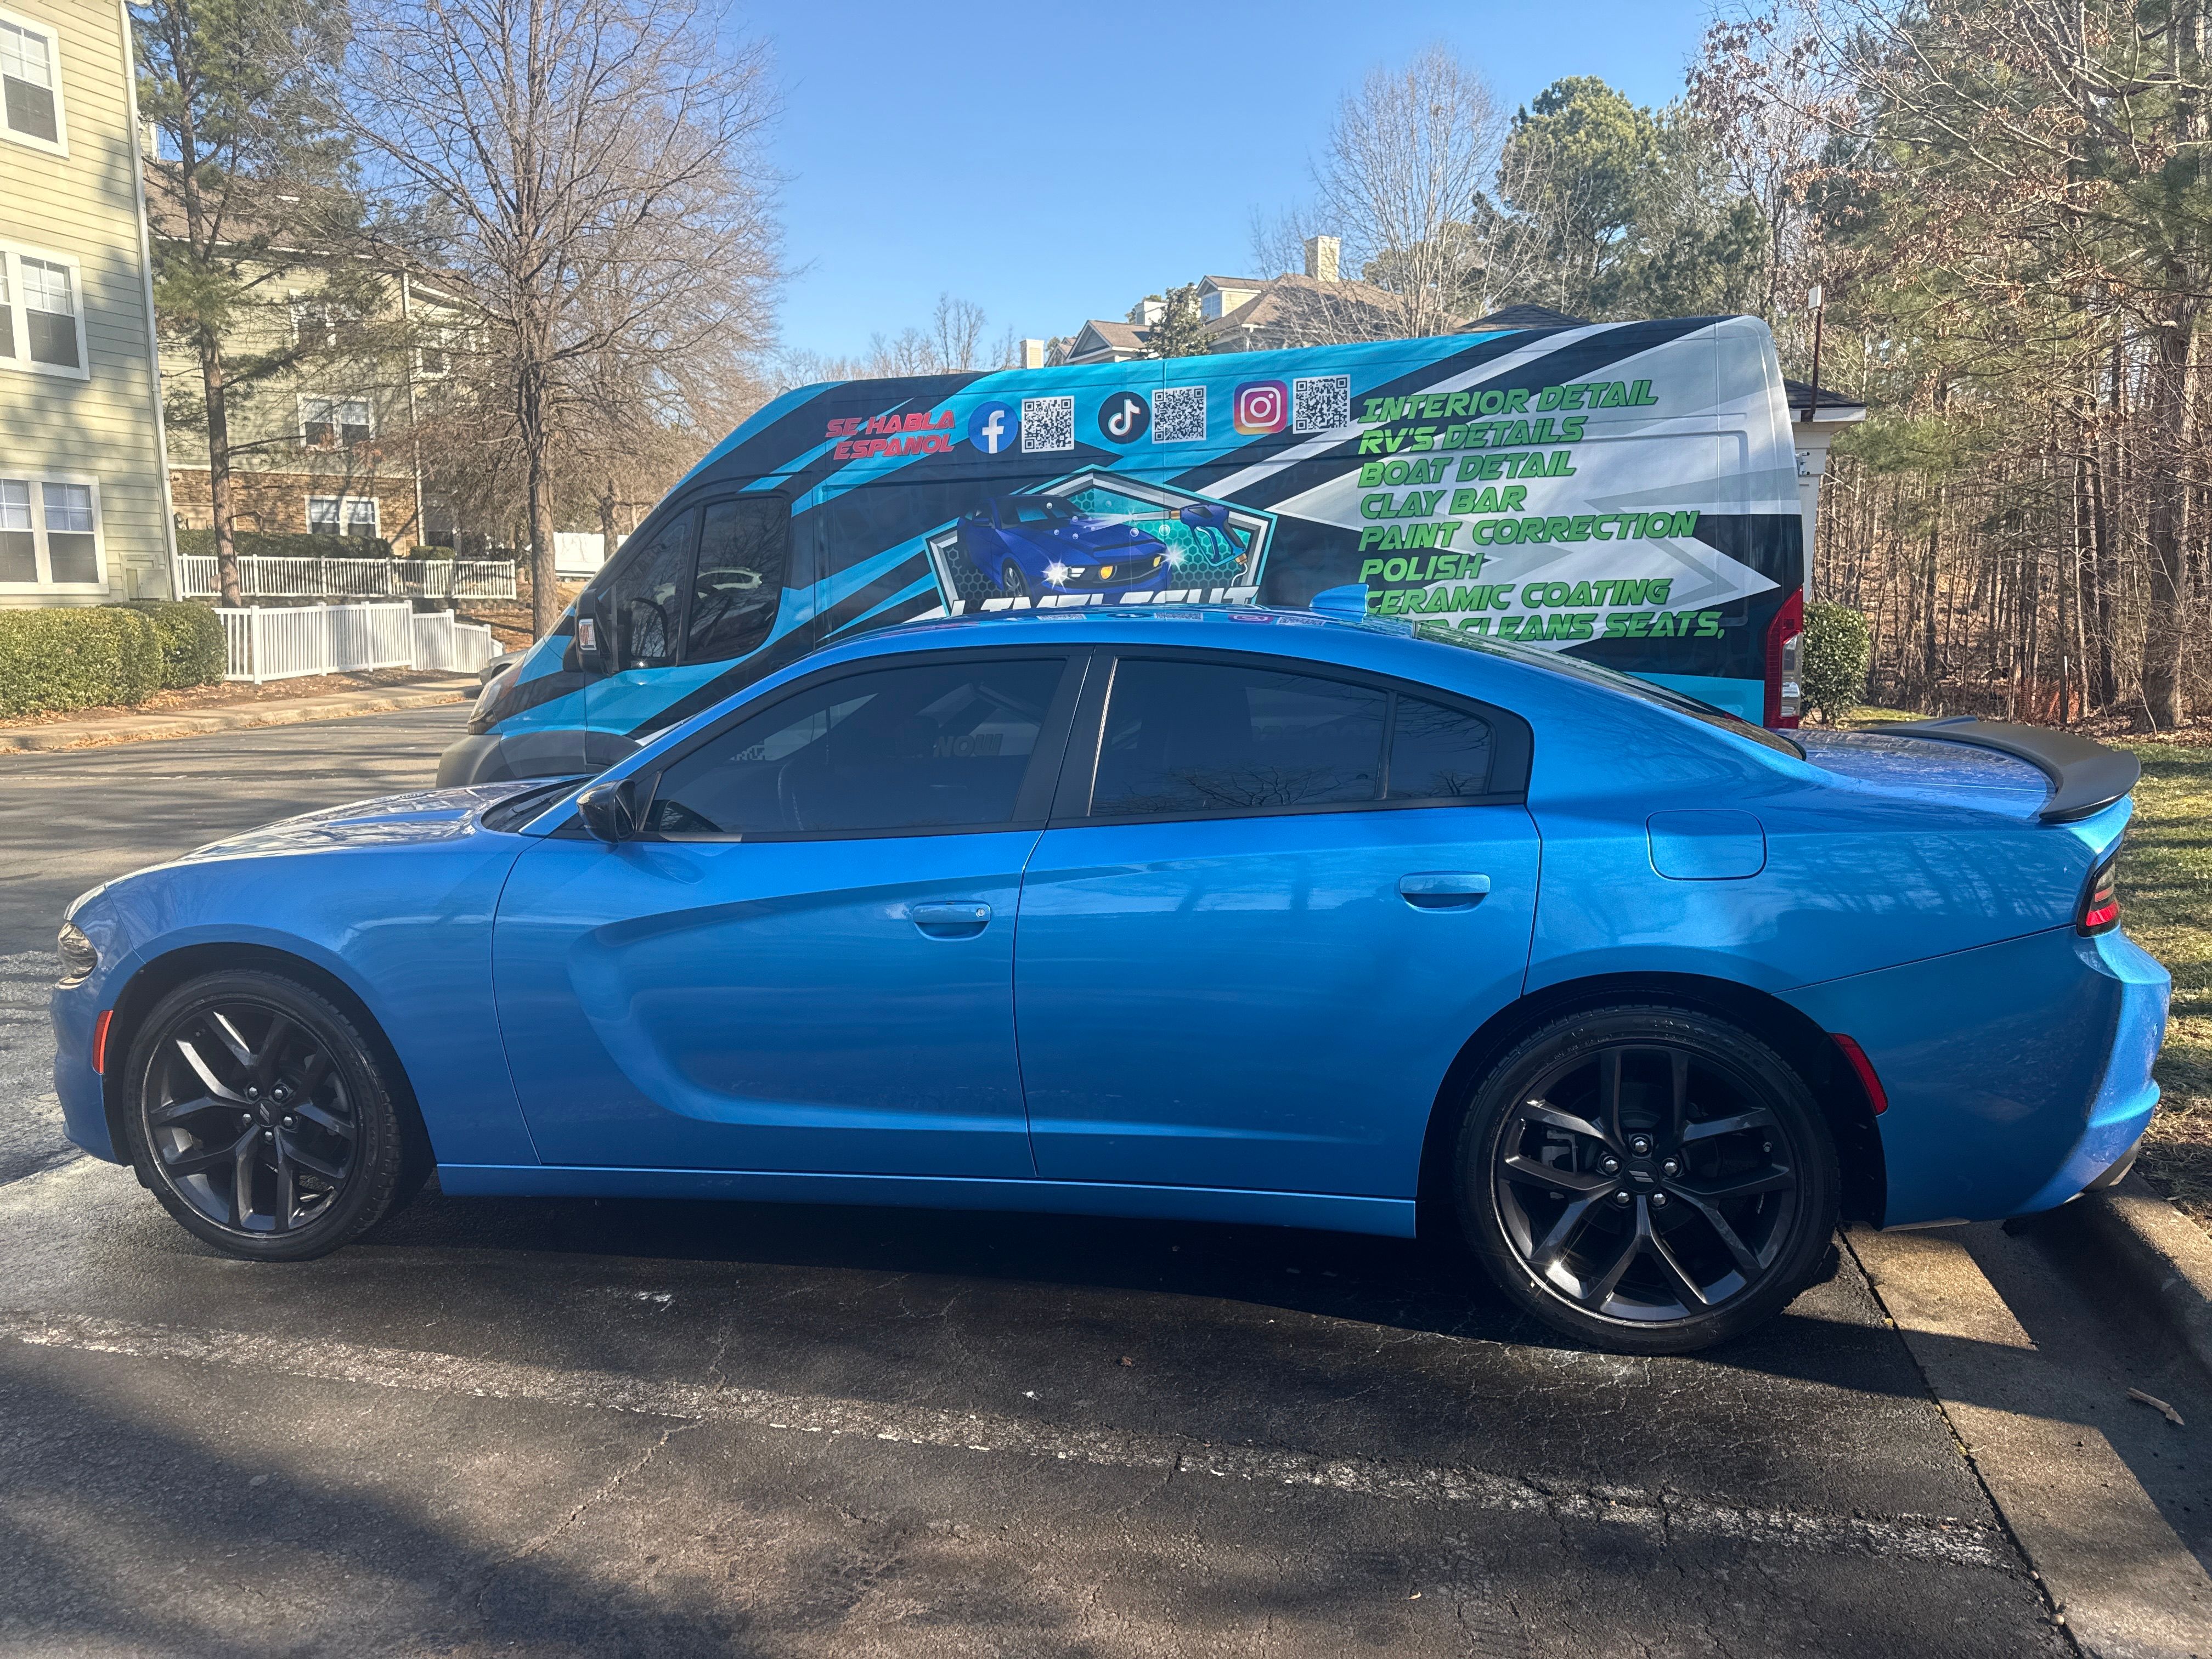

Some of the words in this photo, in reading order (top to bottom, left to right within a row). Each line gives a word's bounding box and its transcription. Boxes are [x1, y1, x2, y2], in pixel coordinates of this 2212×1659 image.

[1358, 388, 1530, 424] INTERIOR
[1537, 379, 1658, 411] DETAIL
[825, 417, 862, 438] SE
[865, 410, 955, 435] HABLA
[1358, 426, 1438, 455] RV'S
[1442, 416, 1588, 450] DETAILS
[833, 434, 955, 460] ESPANOL
[1358, 457, 1453, 488] BOAT
[1455, 450, 1577, 482] DETAIL
[1361, 489, 1447, 519] CLAY
[1449, 485, 1527, 515] BAR
[1358, 522, 1462, 551] PAINT
[1472, 511, 1700, 545] CORRECTION
[1357, 553, 1484, 583] POLISH
[1367, 584, 1515, 615] CERAMIC
[1521, 579, 1673, 608] COATING
[1602, 611, 1725, 640] SEATS,
